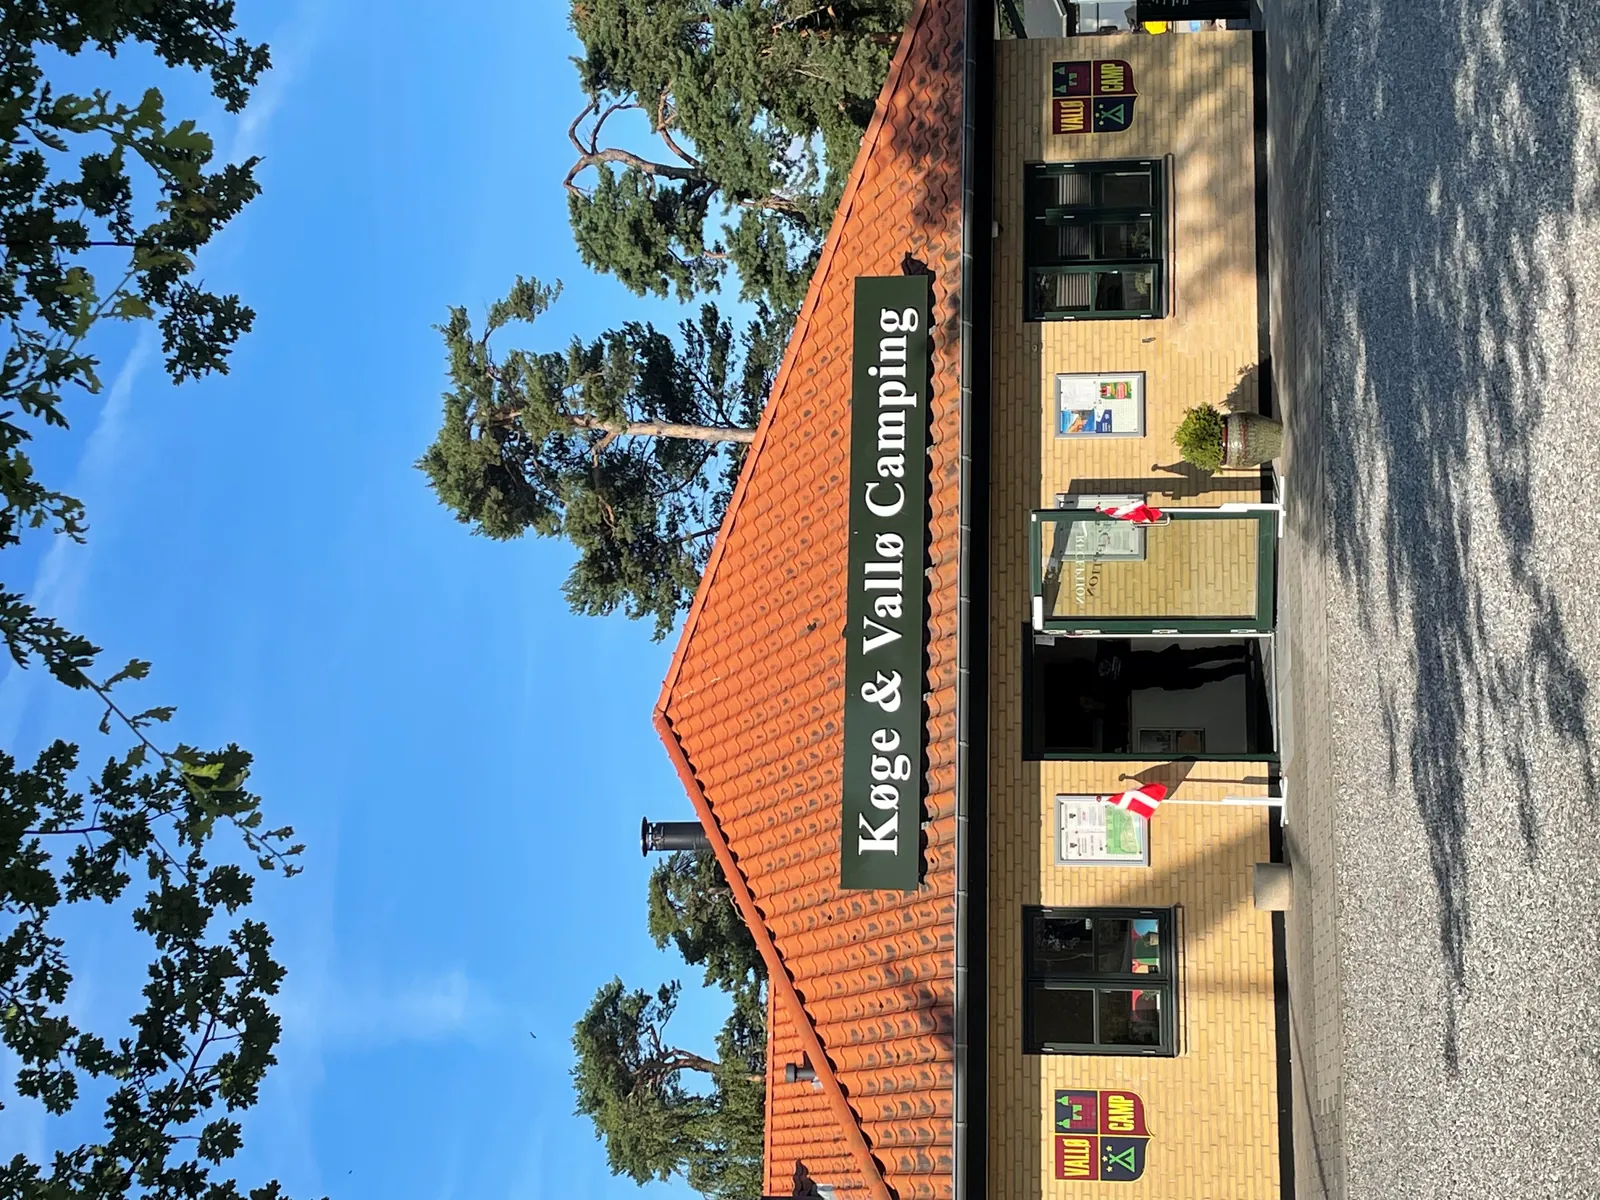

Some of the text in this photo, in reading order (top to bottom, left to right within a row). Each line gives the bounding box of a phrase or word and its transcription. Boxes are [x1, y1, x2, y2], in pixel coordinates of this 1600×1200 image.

[1100, 63, 1125, 92] CAMP
[1059, 99, 1085, 132] VALLØ
[856, 307, 919, 857] Køge & Vallø Camping
[1108, 1095, 1135, 1131] CAMP
[1062, 1138, 1091, 1177] VALLØ
